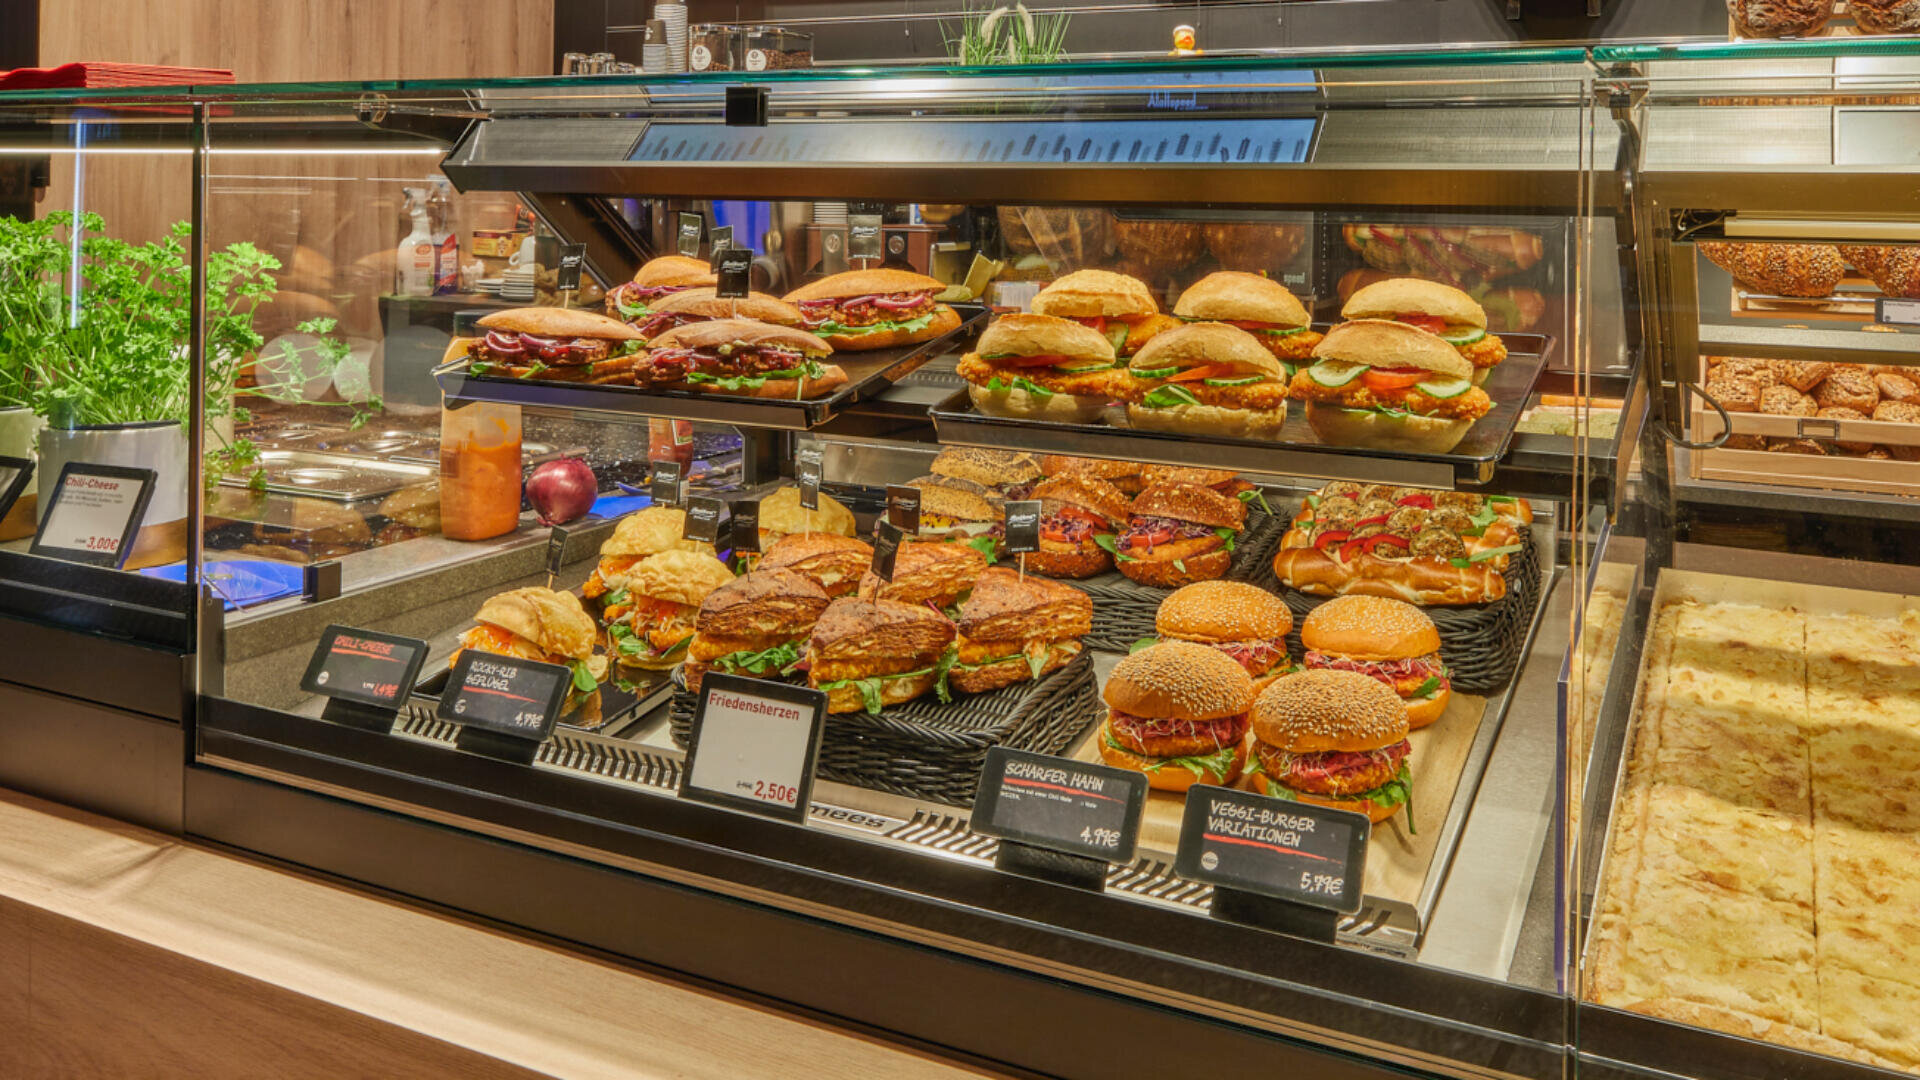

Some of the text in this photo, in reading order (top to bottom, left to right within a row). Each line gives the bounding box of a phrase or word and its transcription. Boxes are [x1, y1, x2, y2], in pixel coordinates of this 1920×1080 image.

[65, 476, 119, 490] Chili-Cheese
[86, 536, 119, 550] 3,00€
[470, 660, 518, 679] ROCKY-RIB
[709, 693, 800, 720] Friedensherzen
[1005, 762, 1104, 791] SCHARFER HAHN
[754, 780, 797, 803] 2,50€
[1211, 799, 1316, 832] VEGGI-BURGER
[1080, 826, 1121, 847] 4,99€
[1207, 815, 1301, 847] VARIATIONEN
